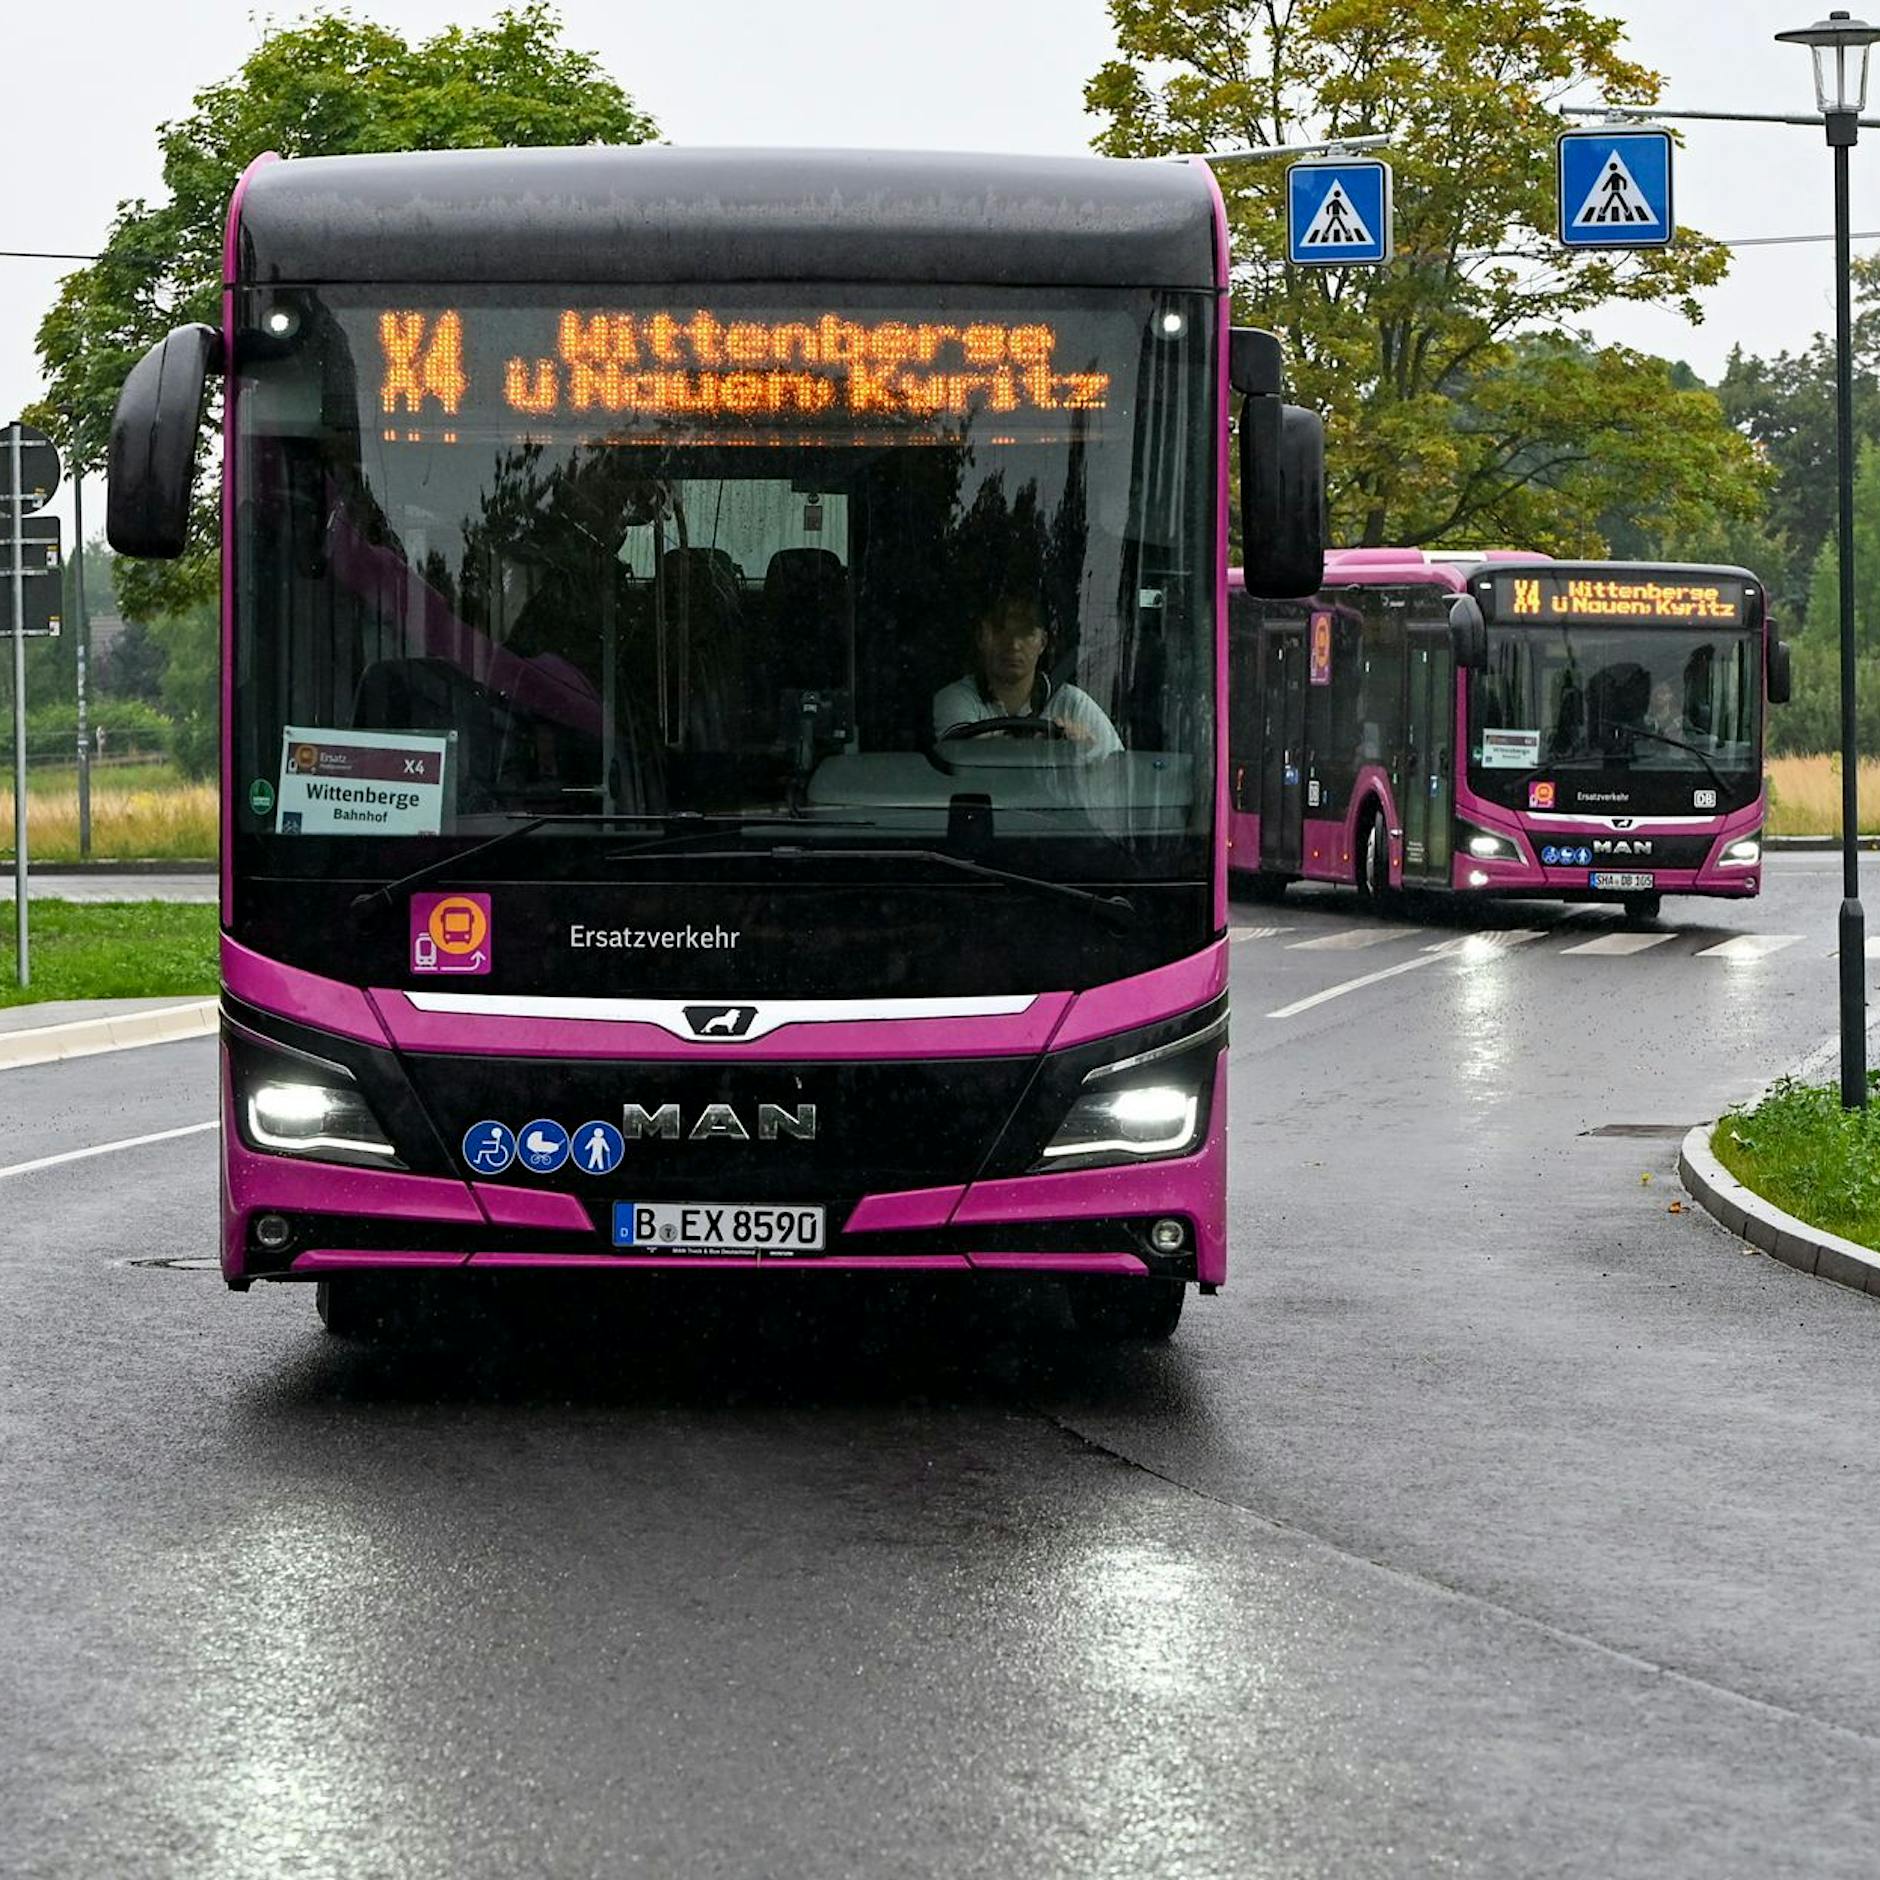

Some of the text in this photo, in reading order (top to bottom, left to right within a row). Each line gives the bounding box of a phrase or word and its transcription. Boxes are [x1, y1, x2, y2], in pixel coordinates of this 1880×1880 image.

[381, 311, 1055, 413] X4 Wittenberge
[849, 360, 1110, 413] Kyritz
[1514, 580, 1719, 614] X4 Wittenberge
[1656, 599, 1735, 617] Kyritz
[403, 759, 425, 775] X4
[307, 783, 420, 810] Wittenberge
[1577, 791, 1629, 802] Ersatzverkehr
[333, 808, 388, 823] Bahnhof
[1593, 839, 1652, 854] MAN
[570, 925, 740, 949] Ersatzverkehr
[623, 1104, 816, 1140] MAN
[620, 1208, 817, 1244] D B EX 8590
